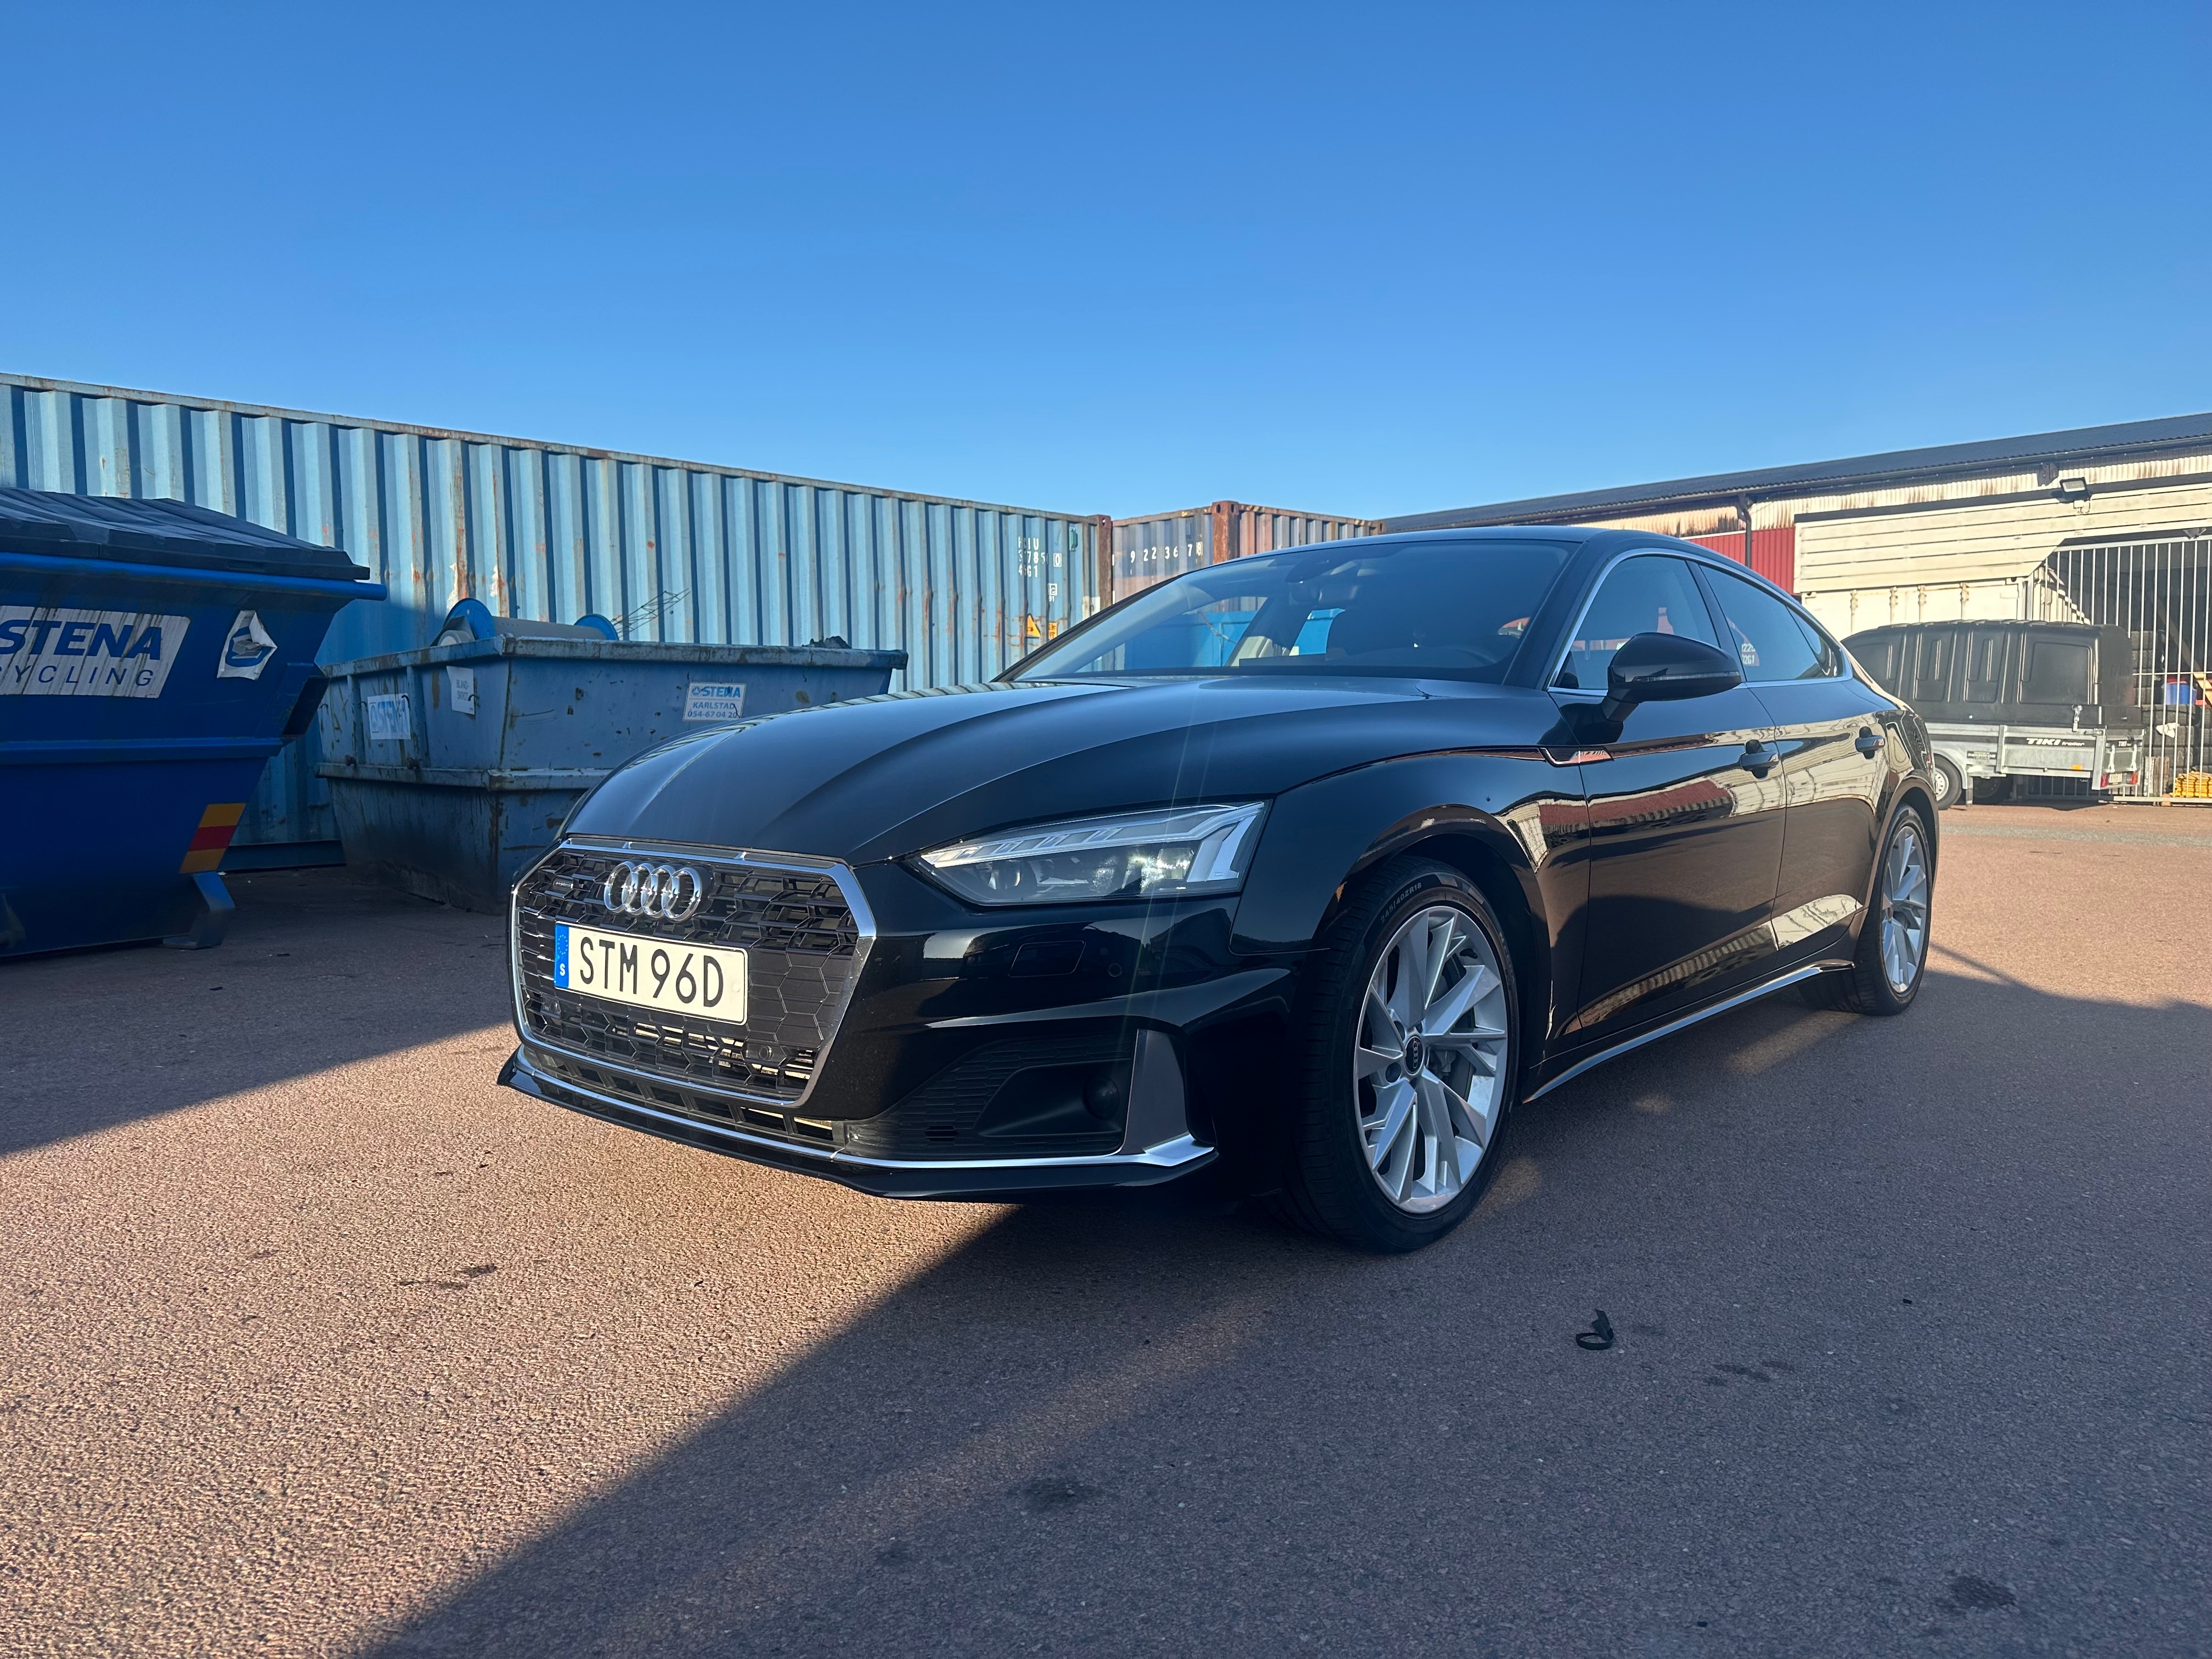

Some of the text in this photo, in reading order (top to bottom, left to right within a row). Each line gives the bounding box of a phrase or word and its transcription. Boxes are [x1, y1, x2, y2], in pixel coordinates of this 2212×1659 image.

[0, 619, 162, 661] STENA
[0, 665, 153, 686] YCLING
[702, 686, 741, 698] STENA
[1380, 882, 1422, 924] 245/40ZR18
[559, 936, 724, 1008] S STM 96D
